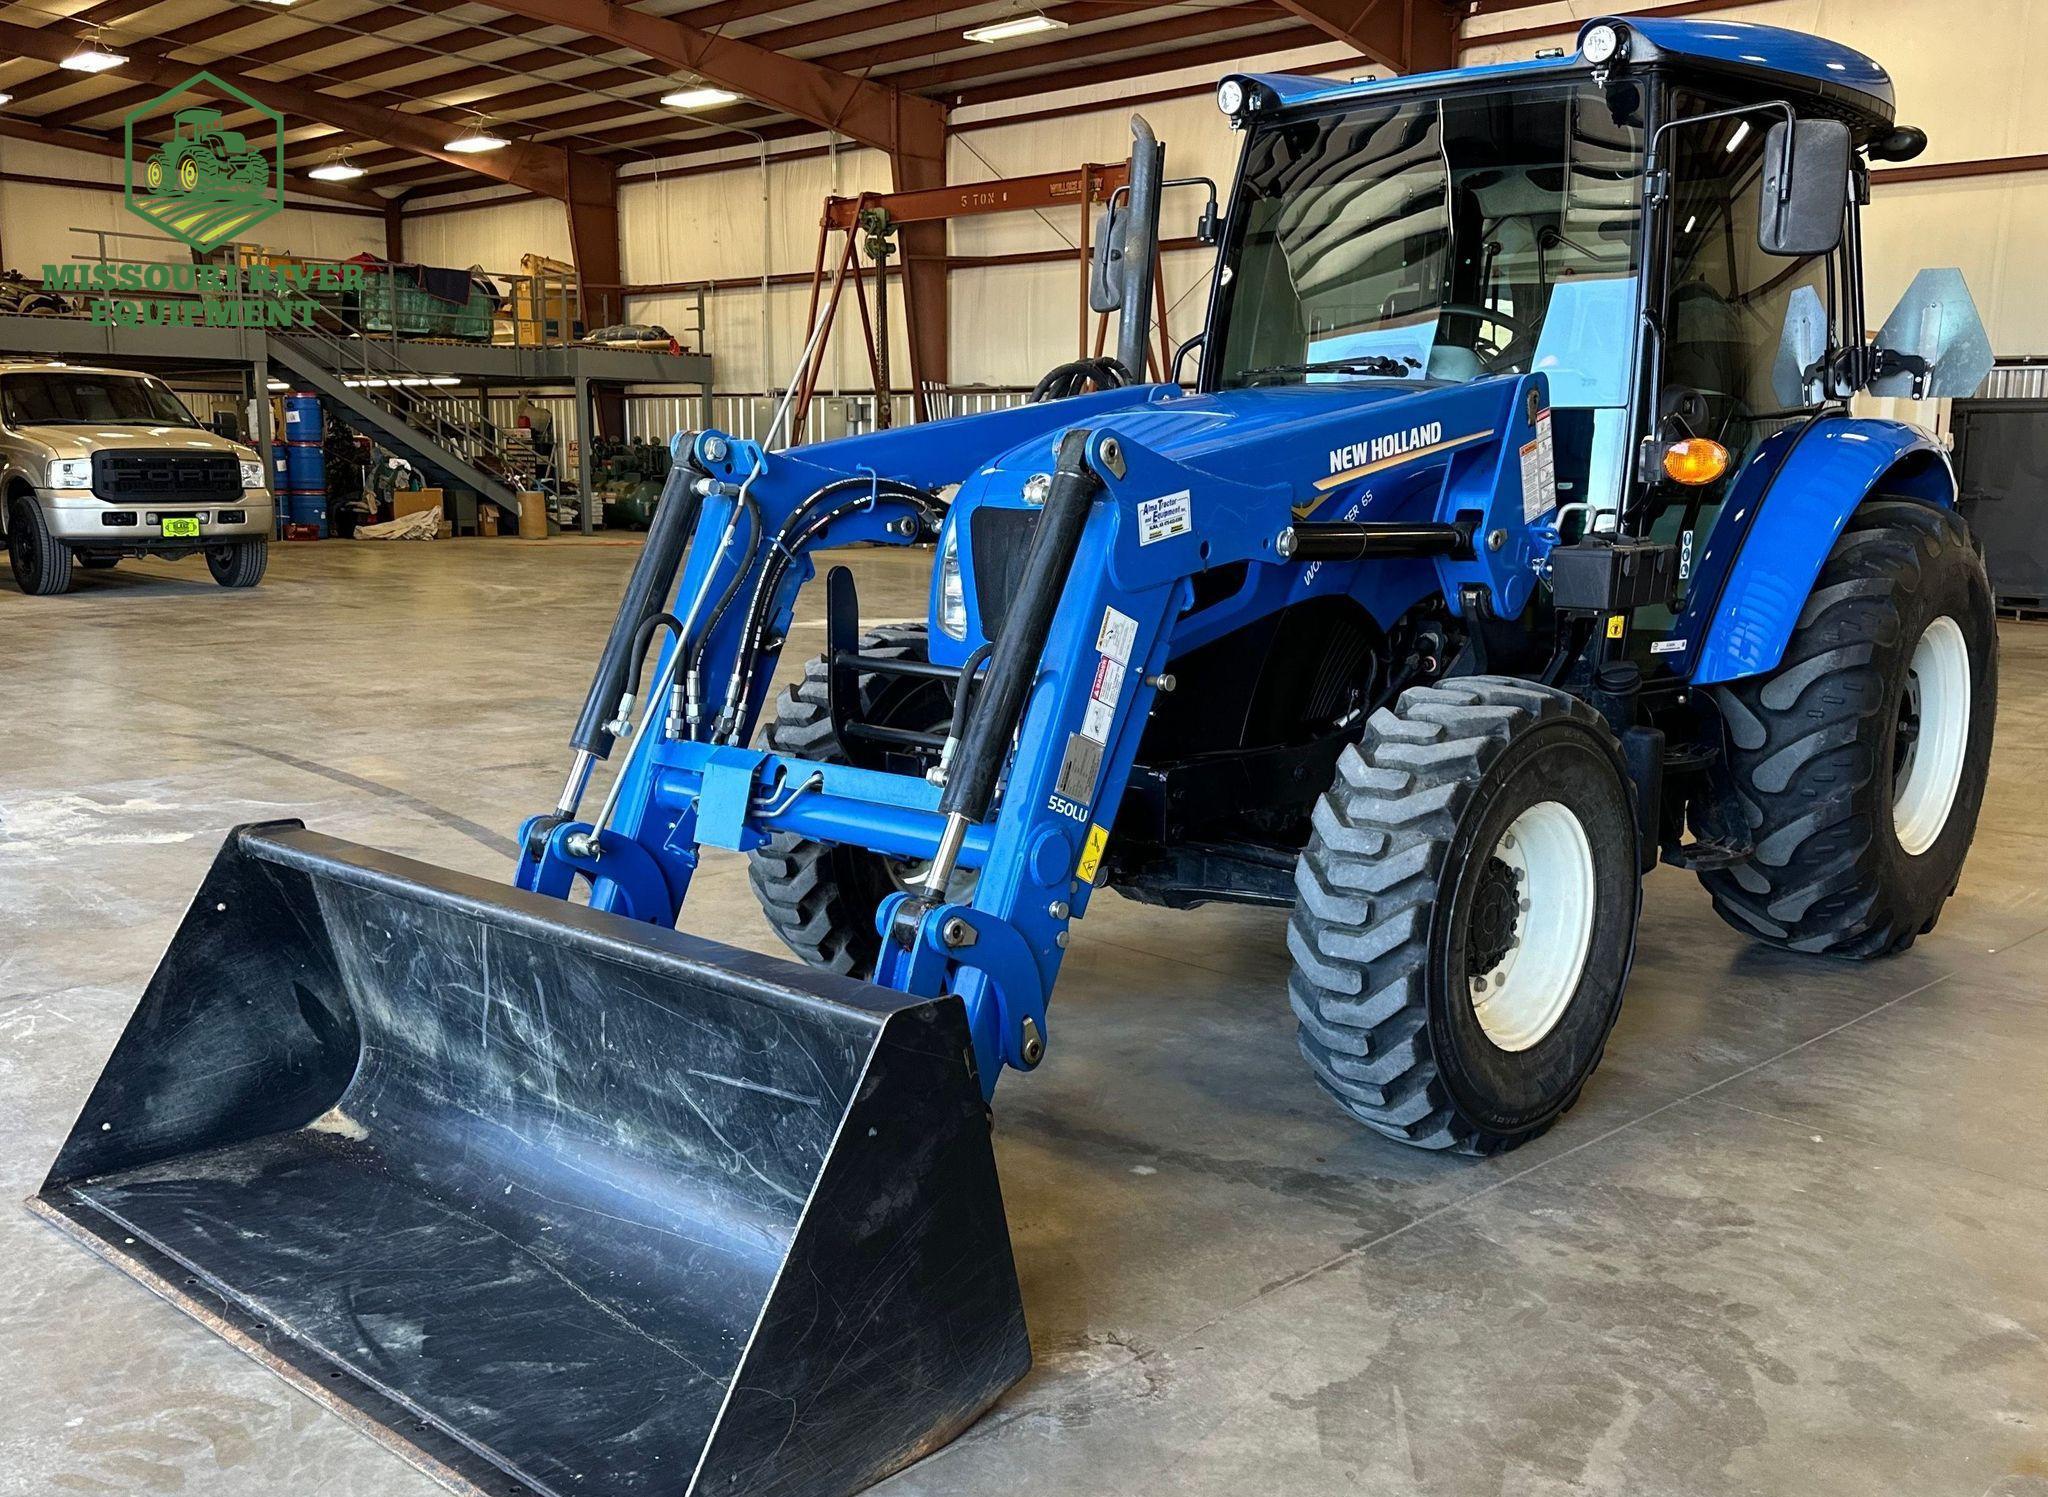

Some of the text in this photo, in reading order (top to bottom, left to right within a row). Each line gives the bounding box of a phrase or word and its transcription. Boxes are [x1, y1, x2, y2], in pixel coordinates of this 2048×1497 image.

[960, 195, 968, 207] 5
[972, 192, 995, 206] TON
[1329, 421, 1443, 474] NEW HOLLAND
[107, 468, 233, 483] FORD
[1158, 499, 1178, 511] Tractor
[1361, 489, 1374, 507] 65
[1152, 506, 1181, 523] Equipment
[1047, 794, 1089, 823] 550LU
